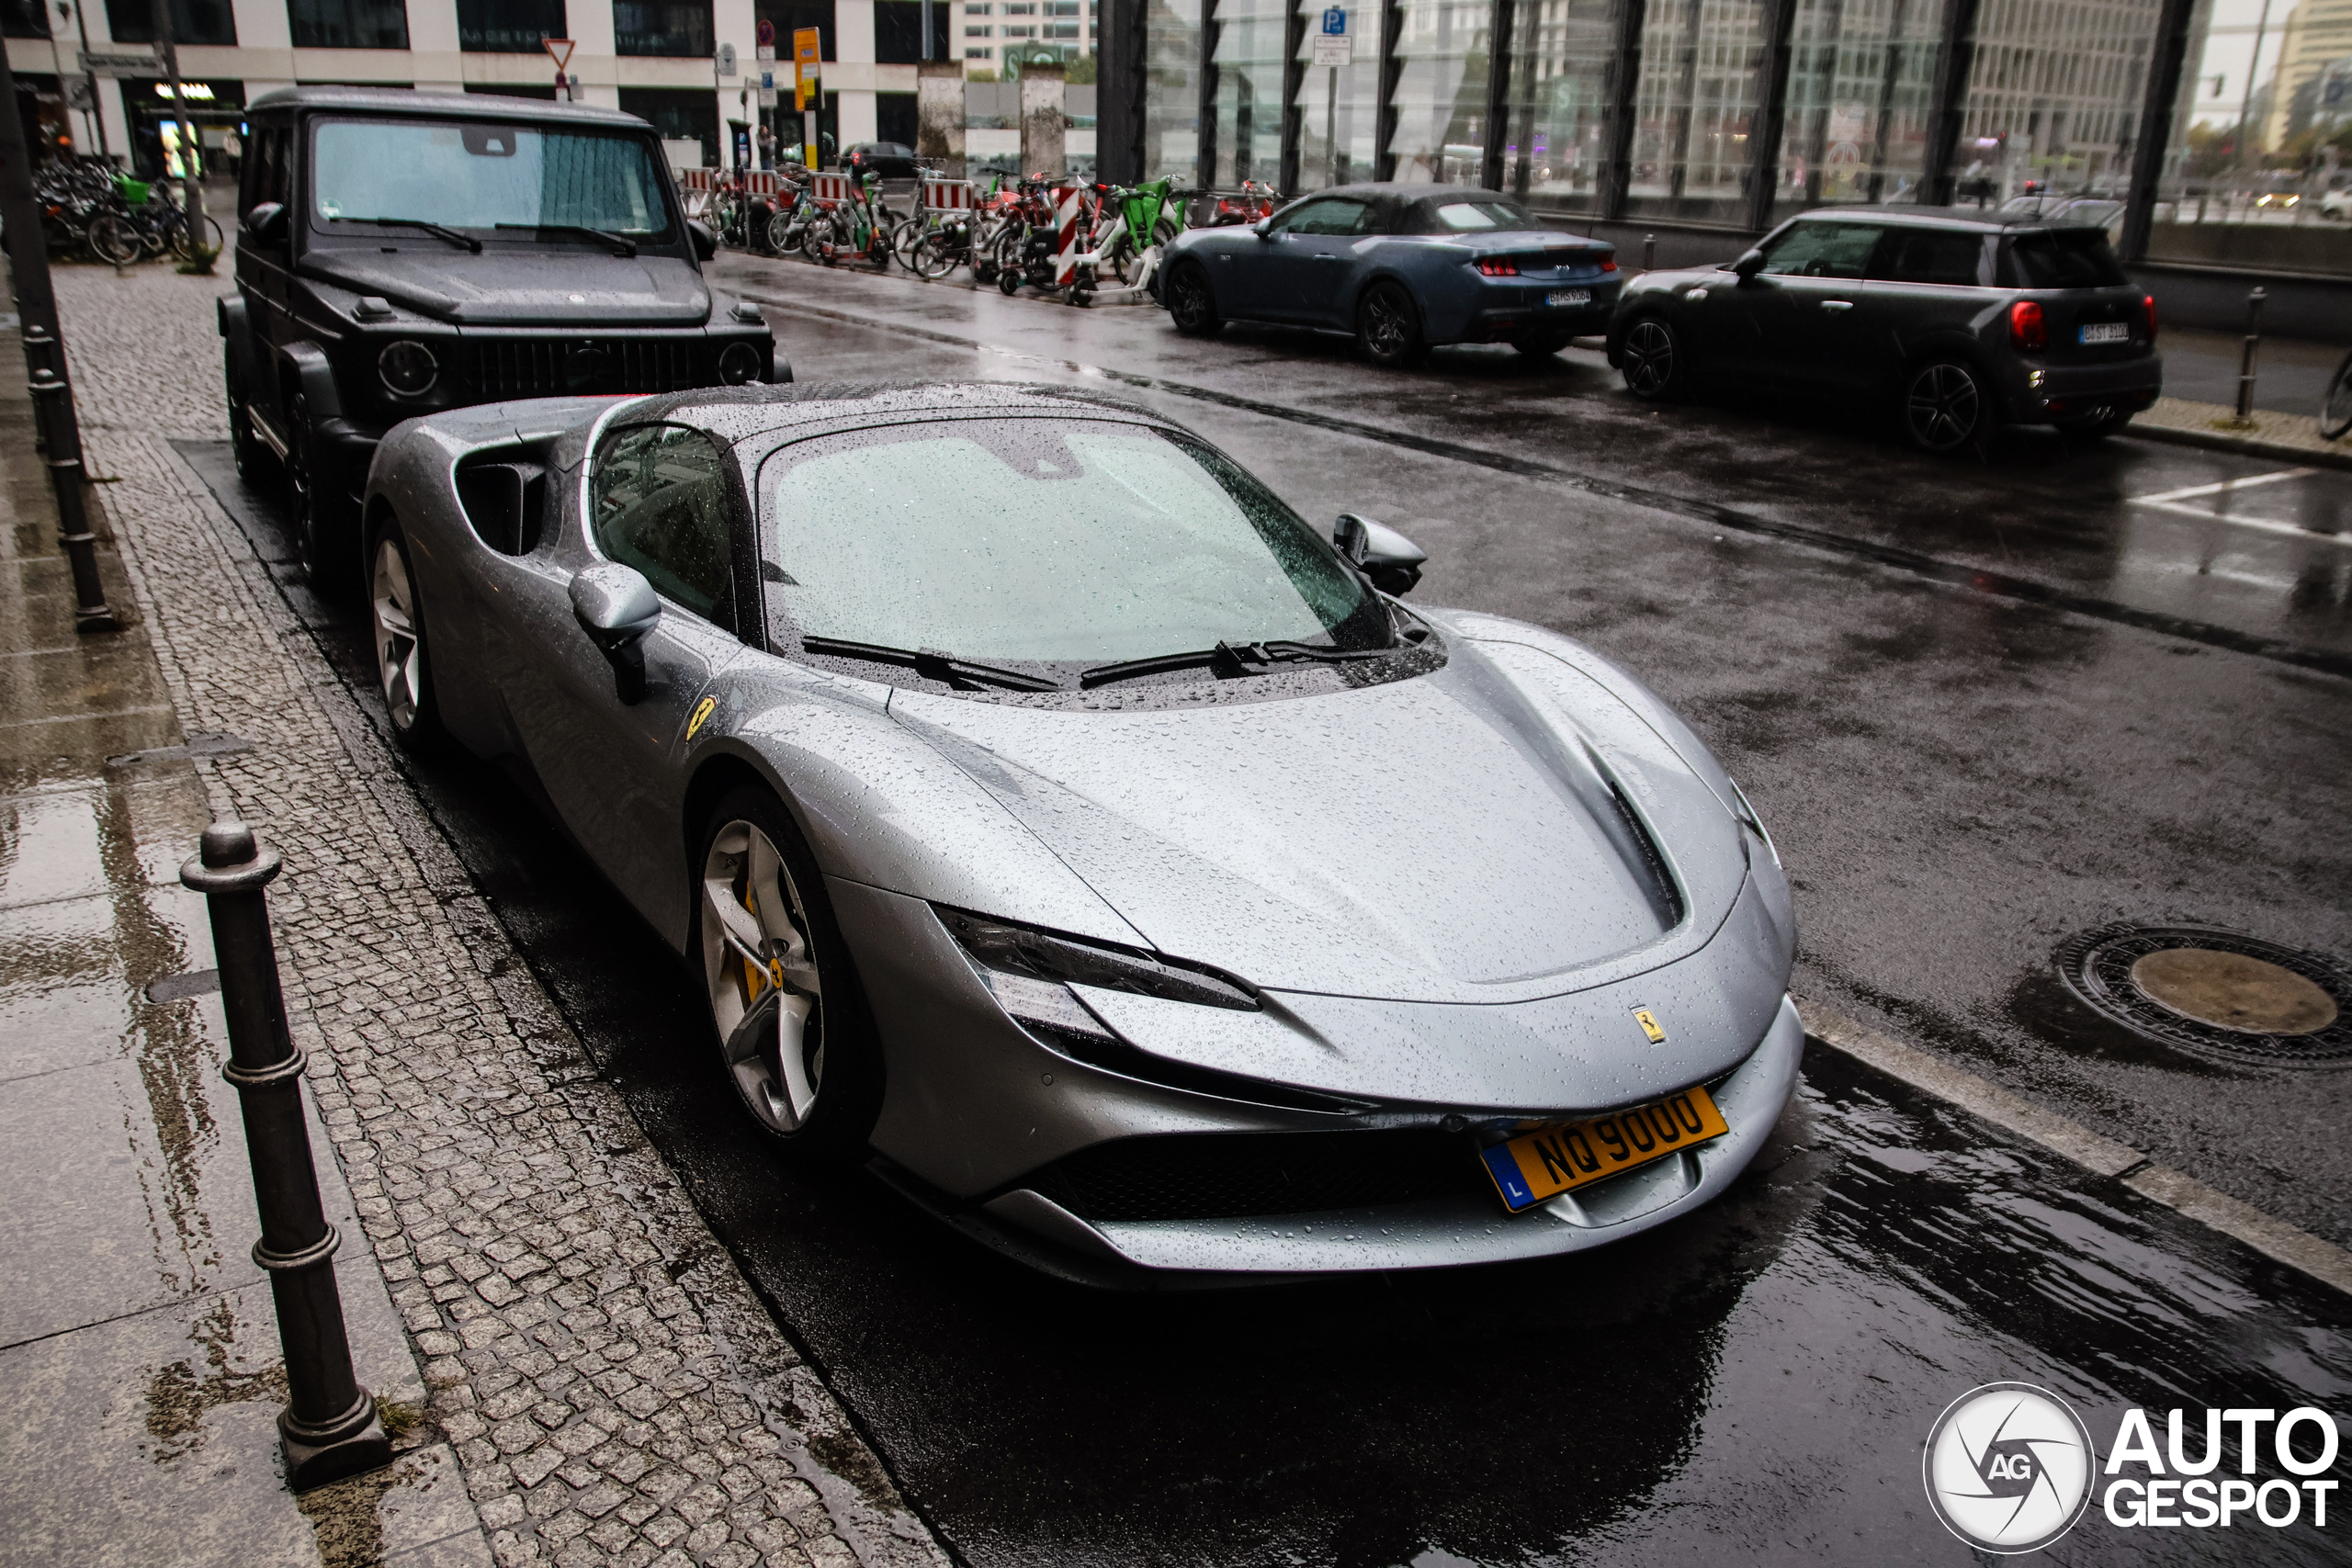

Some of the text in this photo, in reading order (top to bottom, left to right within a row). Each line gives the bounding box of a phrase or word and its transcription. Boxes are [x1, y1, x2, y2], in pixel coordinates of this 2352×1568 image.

[1327, 11, 1340, 30] P
[1550, 292, 1555, 302] B
[1533, 1095, 1703, 1185] NQ 9000
[1508, 1181, 1522, 1198] L
